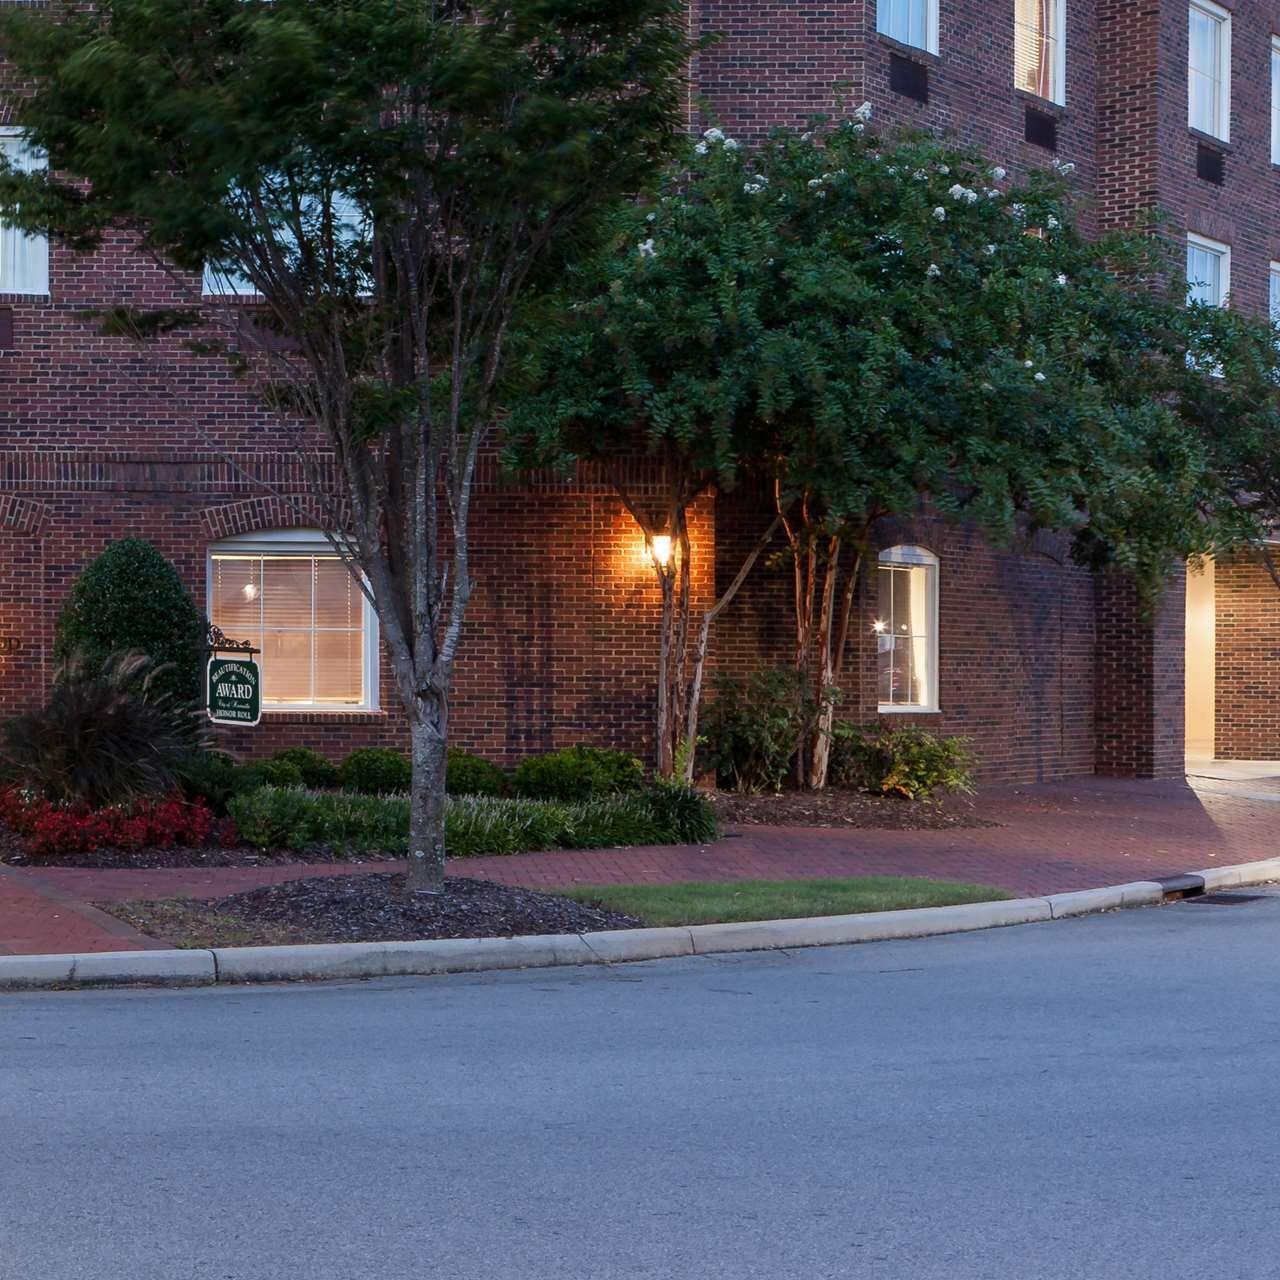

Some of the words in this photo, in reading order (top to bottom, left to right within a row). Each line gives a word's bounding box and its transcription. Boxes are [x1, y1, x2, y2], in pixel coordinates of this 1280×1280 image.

[211, 663, 256, 684] BEAUTIFICATION
[216, 683, 253, 699] AWARD
[216, 709, 237, 718] HONOR
[237, 710, 251, 719] ROLL
